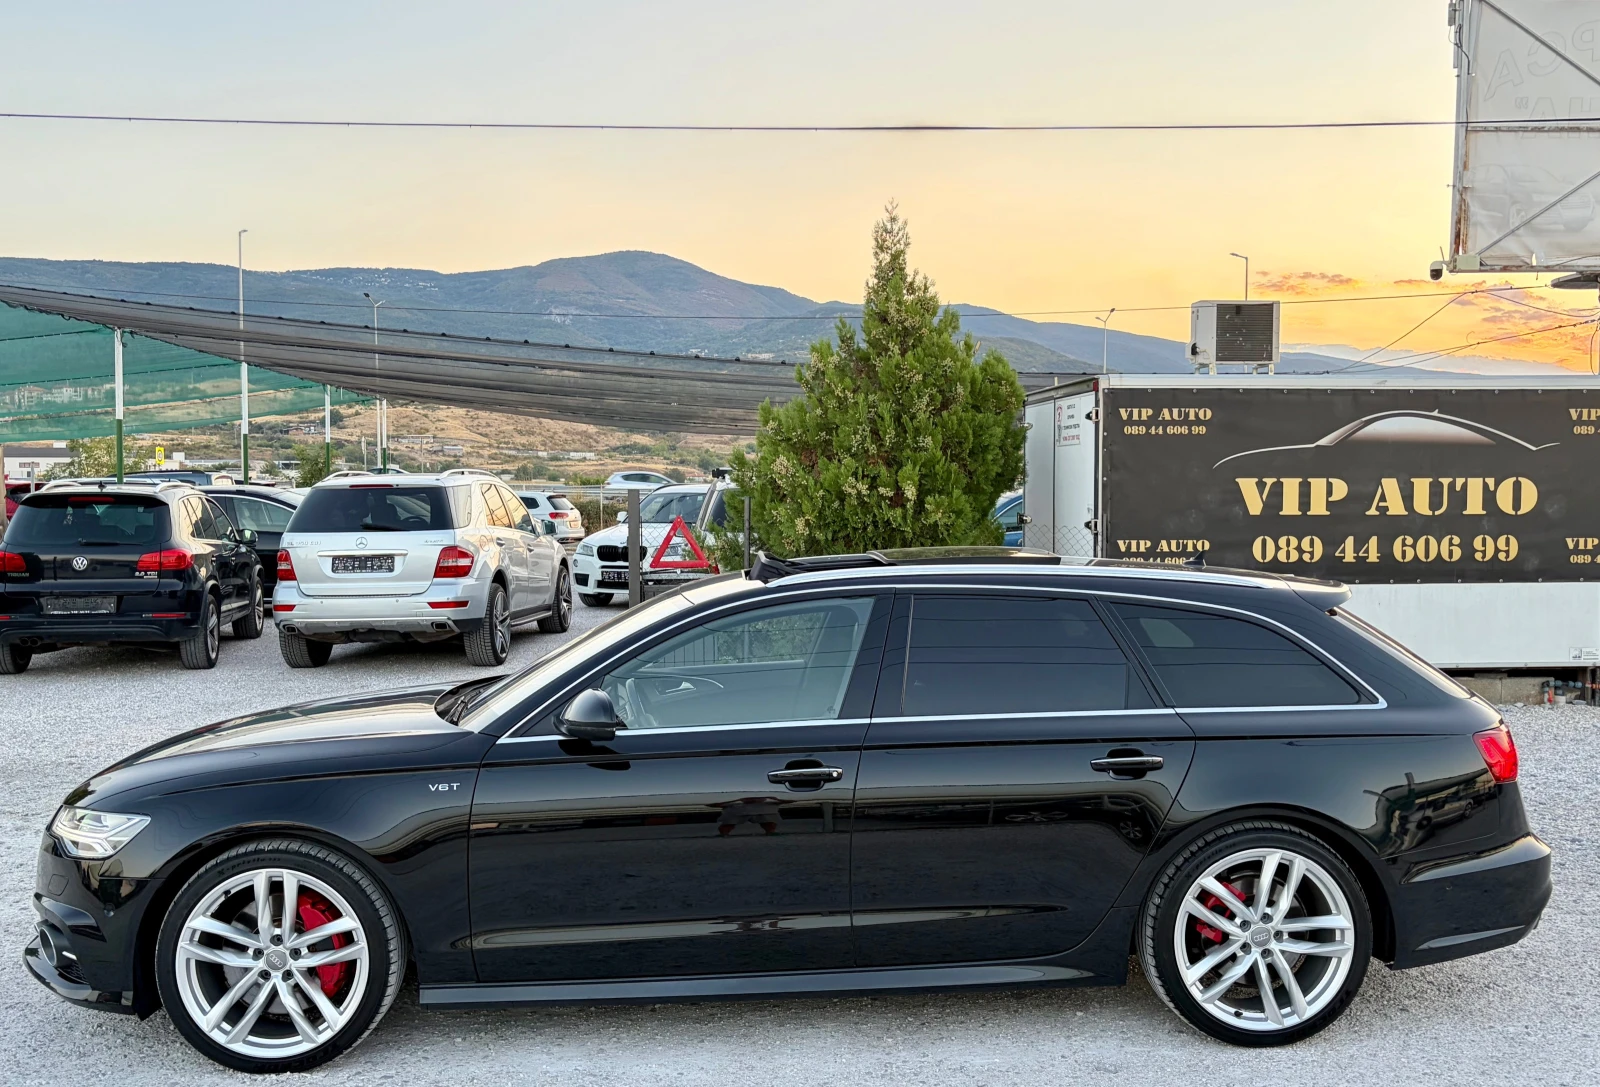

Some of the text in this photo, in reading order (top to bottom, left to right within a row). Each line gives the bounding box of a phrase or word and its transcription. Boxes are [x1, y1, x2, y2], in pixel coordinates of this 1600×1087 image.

[1119, 408, 1212, 420] VIP AUTO
[1569, 408, 1600, 420] VIP
[1124, 425, 1206, 435] 089 44 606 99
[1573, 425, 1595, 435] 089
[1235, 476, 1538, 516] VIP AUTO
[1117, 539, 1210, 552] VIP AUTO
[1252, 534, 1519, 563] 089 44 606 99
[1565, 537, 1599, 550] VIP
[1569, 554, 1592, 564] 089
